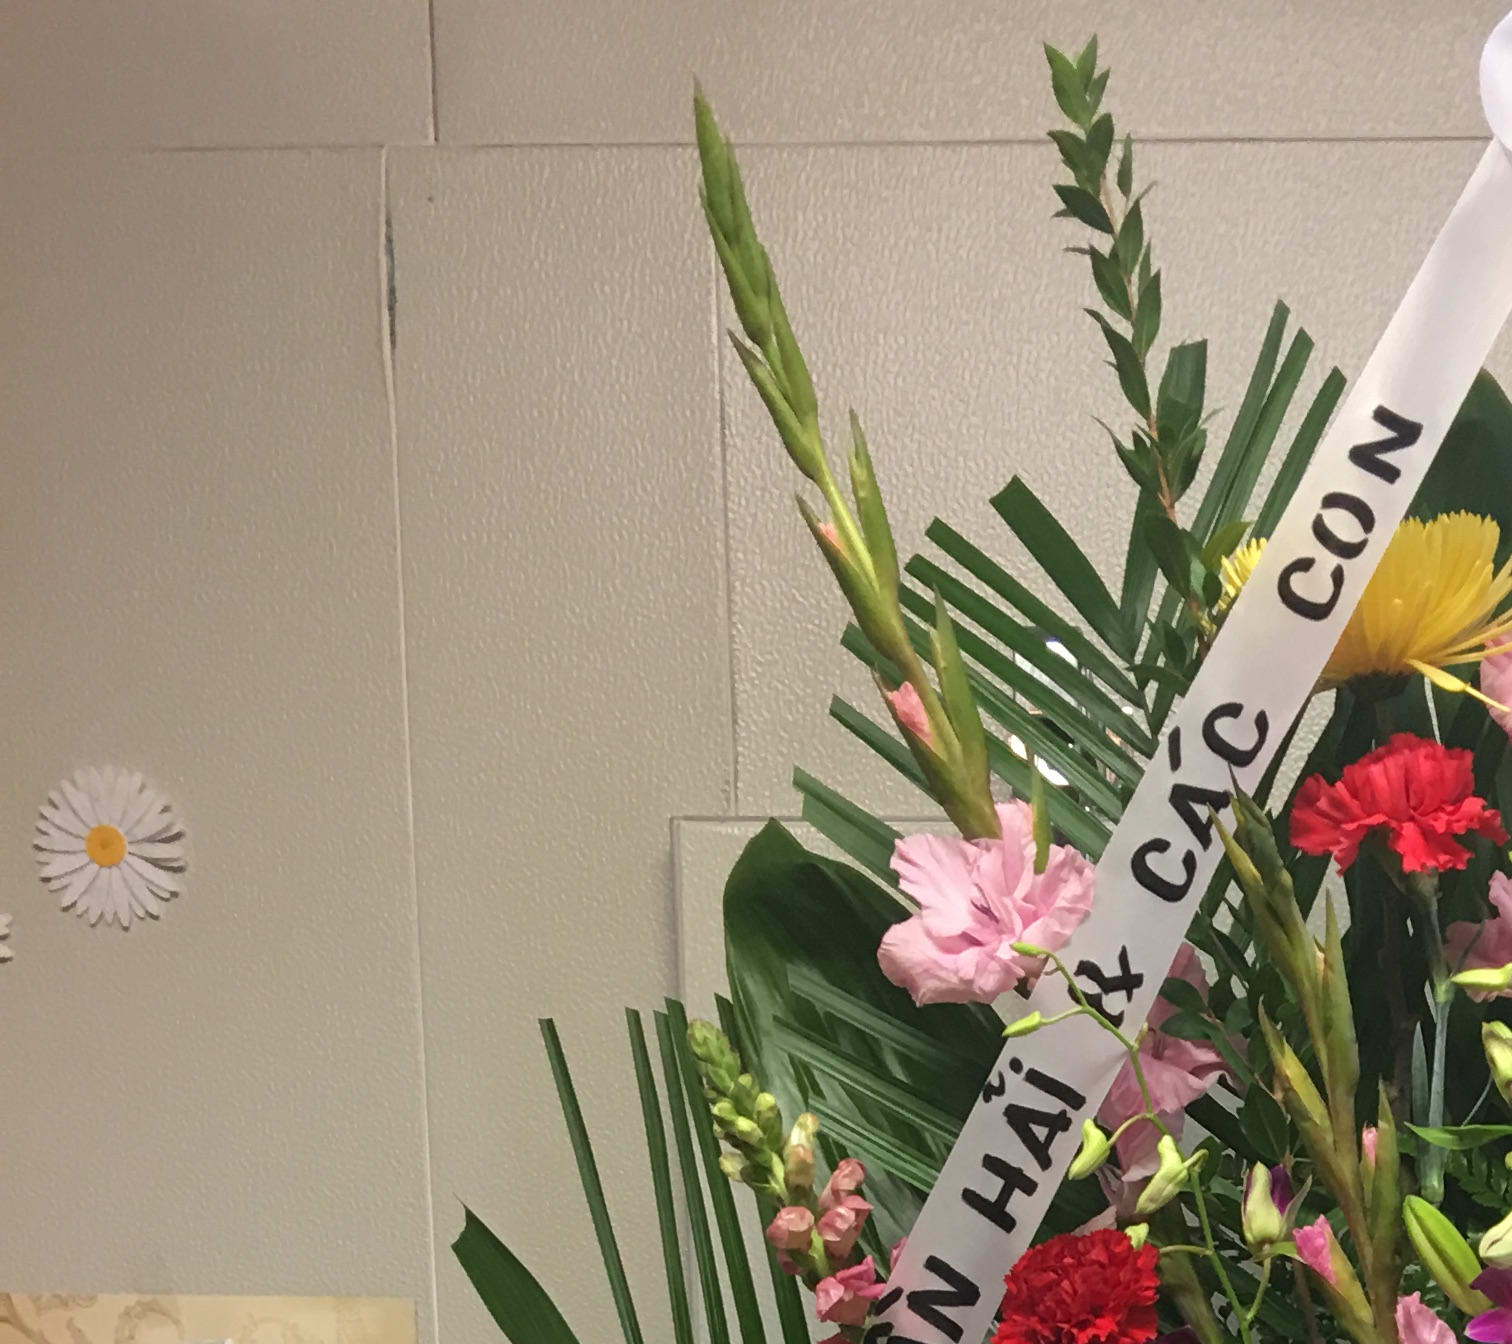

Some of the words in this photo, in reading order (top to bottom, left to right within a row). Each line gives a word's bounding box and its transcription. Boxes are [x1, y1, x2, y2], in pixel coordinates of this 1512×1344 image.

[1067, 944, 1144, 1029] &
[1131, 701, 1268, 904] CÁC
[1277, 404, 1424, 622] CON
